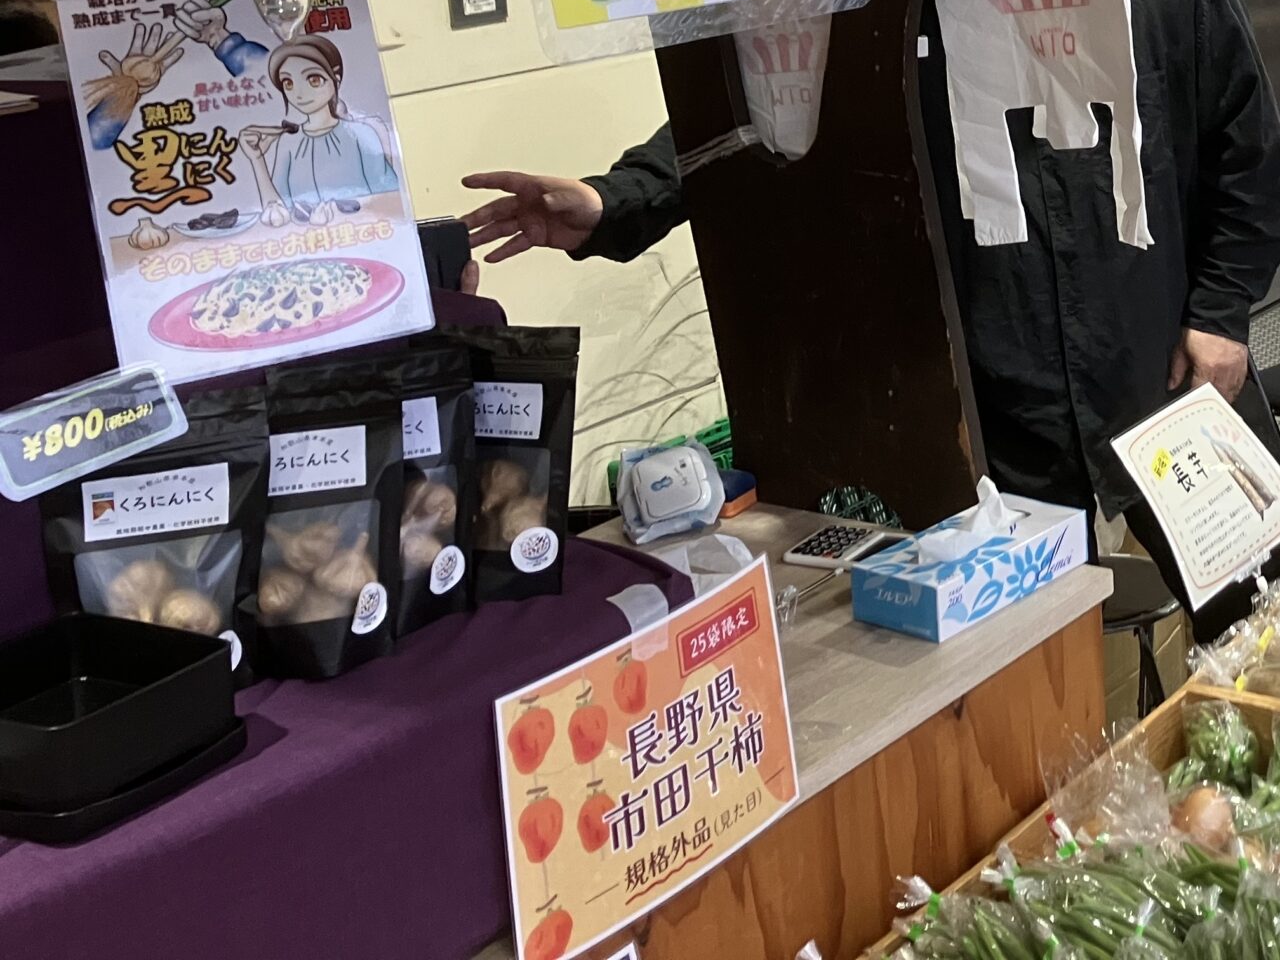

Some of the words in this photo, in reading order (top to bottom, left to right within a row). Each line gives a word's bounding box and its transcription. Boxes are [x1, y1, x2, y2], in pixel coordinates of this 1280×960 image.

[140, 98, 196, 128] 熟成
[139, 219, 394, 282] そのままでもお料理でも
[119, 487, 215, 512] くろにんにく
[690, 607, 750, 659] 25袋限定
[621, 667, 742, 781] 長野県
[604, 712, 764, 852] 市田干柿
